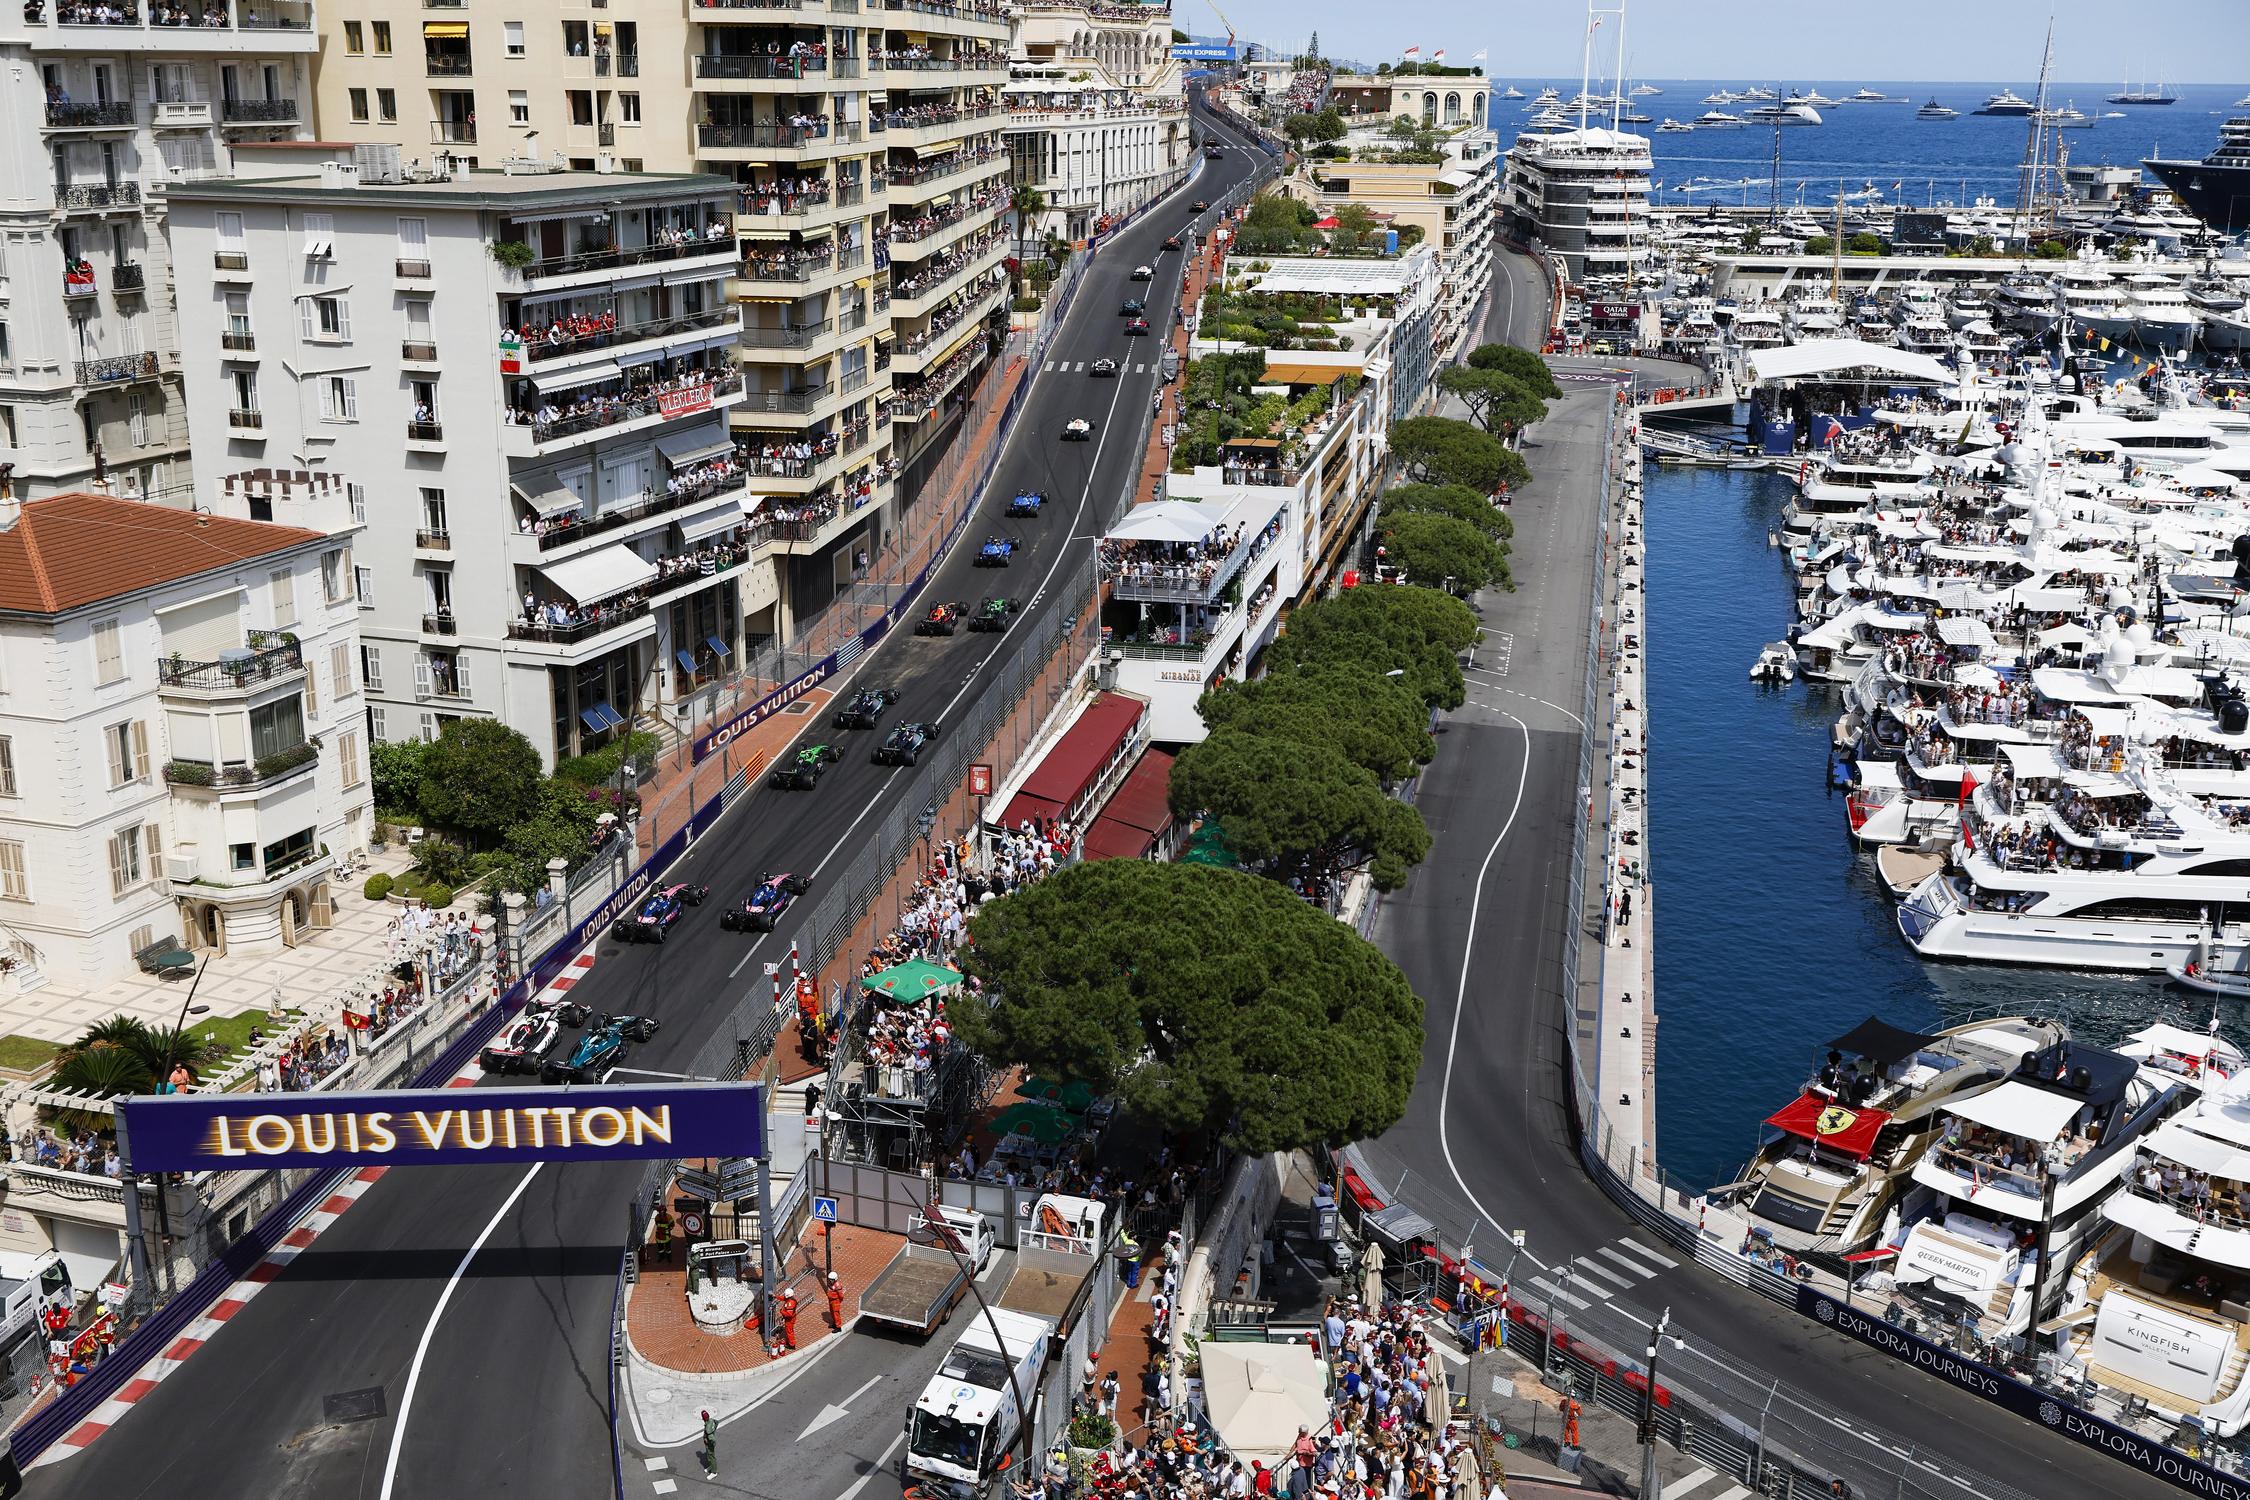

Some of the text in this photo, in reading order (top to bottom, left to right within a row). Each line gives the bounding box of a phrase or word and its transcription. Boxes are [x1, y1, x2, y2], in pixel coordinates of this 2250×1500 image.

[1603, 305, 1628, 314] QATAR
[1640, 350, 1683, 362] QATAR AIRWAYS
[666, 387, 707, 410] LECLERC
[925, 516, 966, 581] LOUIS VUITTON
[708, 665, 826, 751] LOUIS VUITTON
[582, 868, 649, 943] LOUIS VUITTON
[218, 1105, 672, 1156] LOUIS VUITTON
[1917, 1251, 1980, 1278] QUEEN MARTINA
[1838, 1311, 1999, 1396] EXPLORA JOURNEYS
[2127, 1326, 2190, 1354] KINGFISH
[2141, 1342, 2171, 1356] VALLETTA
[2066, 1414, 2250, 1500] EXPLORA JOURNEY
